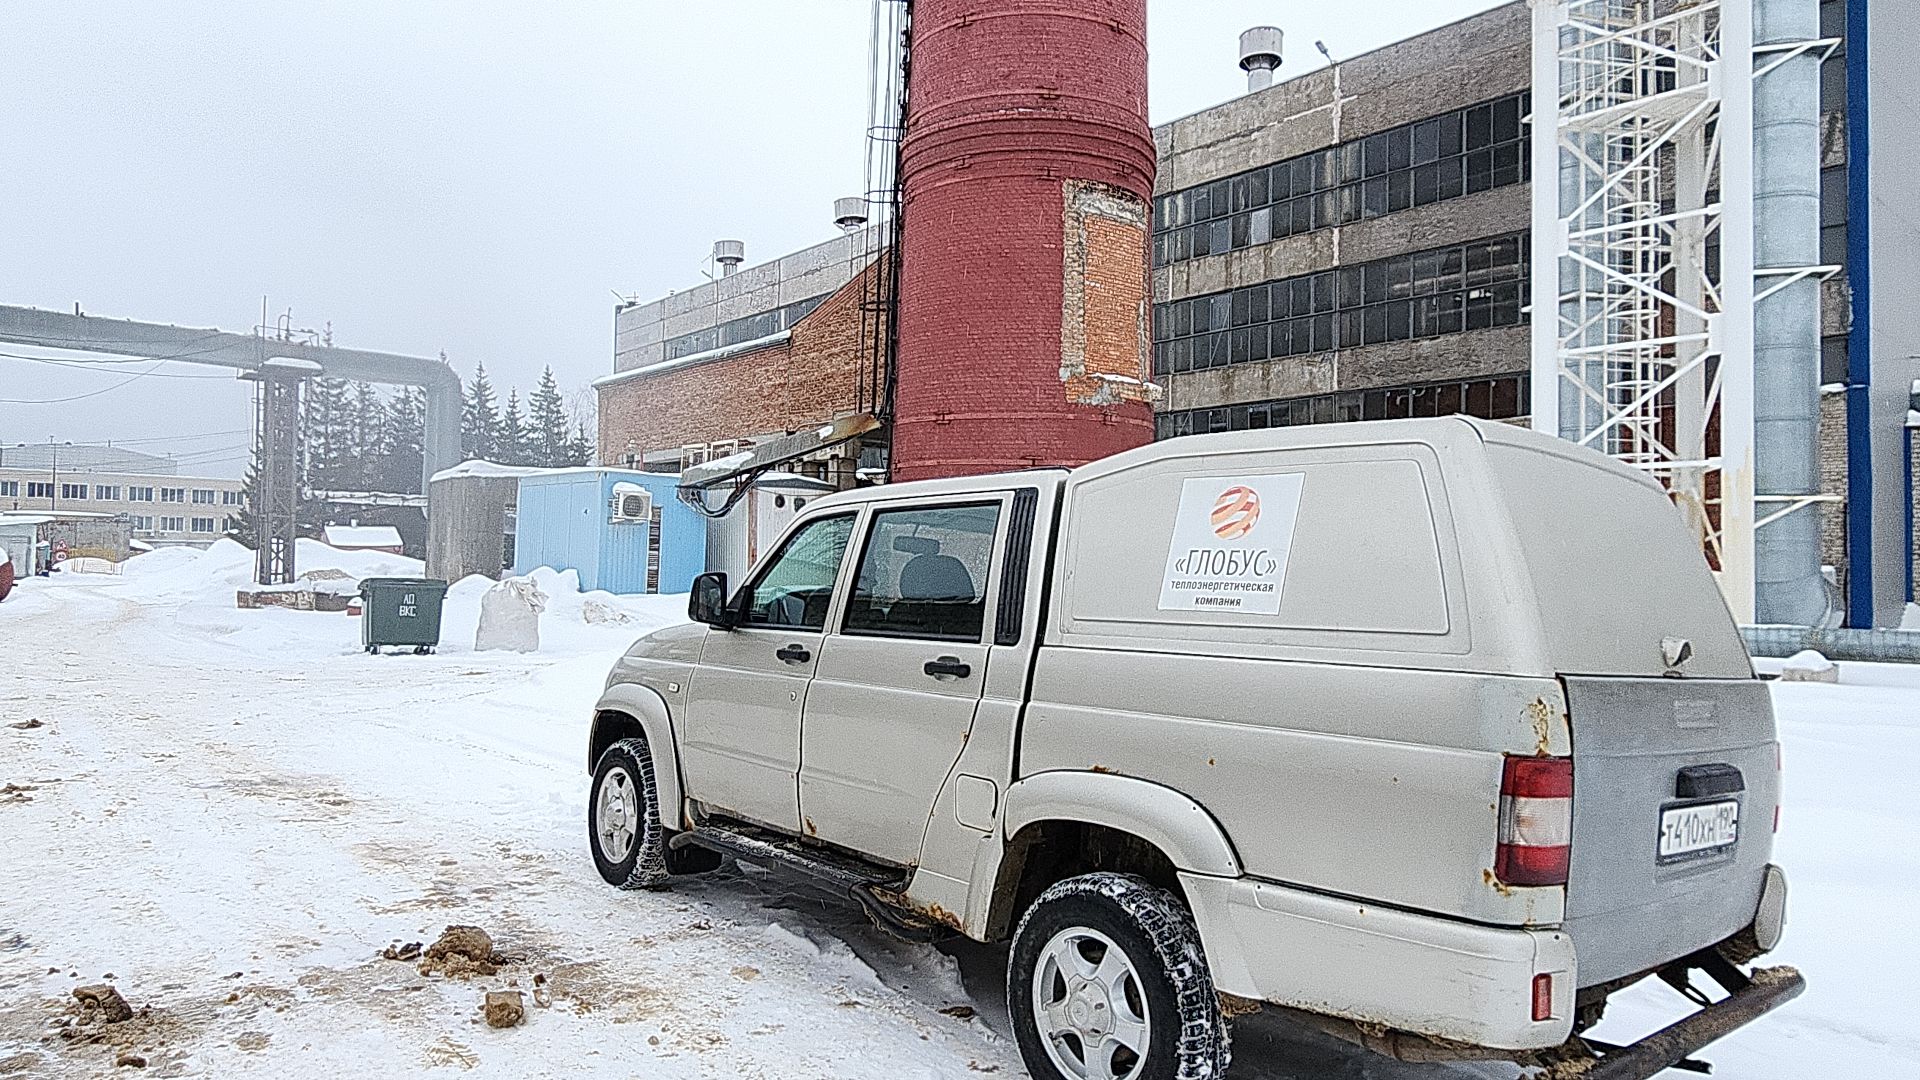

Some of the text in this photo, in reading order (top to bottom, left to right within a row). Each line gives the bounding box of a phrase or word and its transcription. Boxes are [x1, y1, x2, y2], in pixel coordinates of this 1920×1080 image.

[1175, 549, 1277, 577] «ГЛОБУС»
[1171, 580, 1274, 593] теплоэнергетическая
[1194, 596, 1242, 607] компания
[399, 605, 416, 617] ВКС
